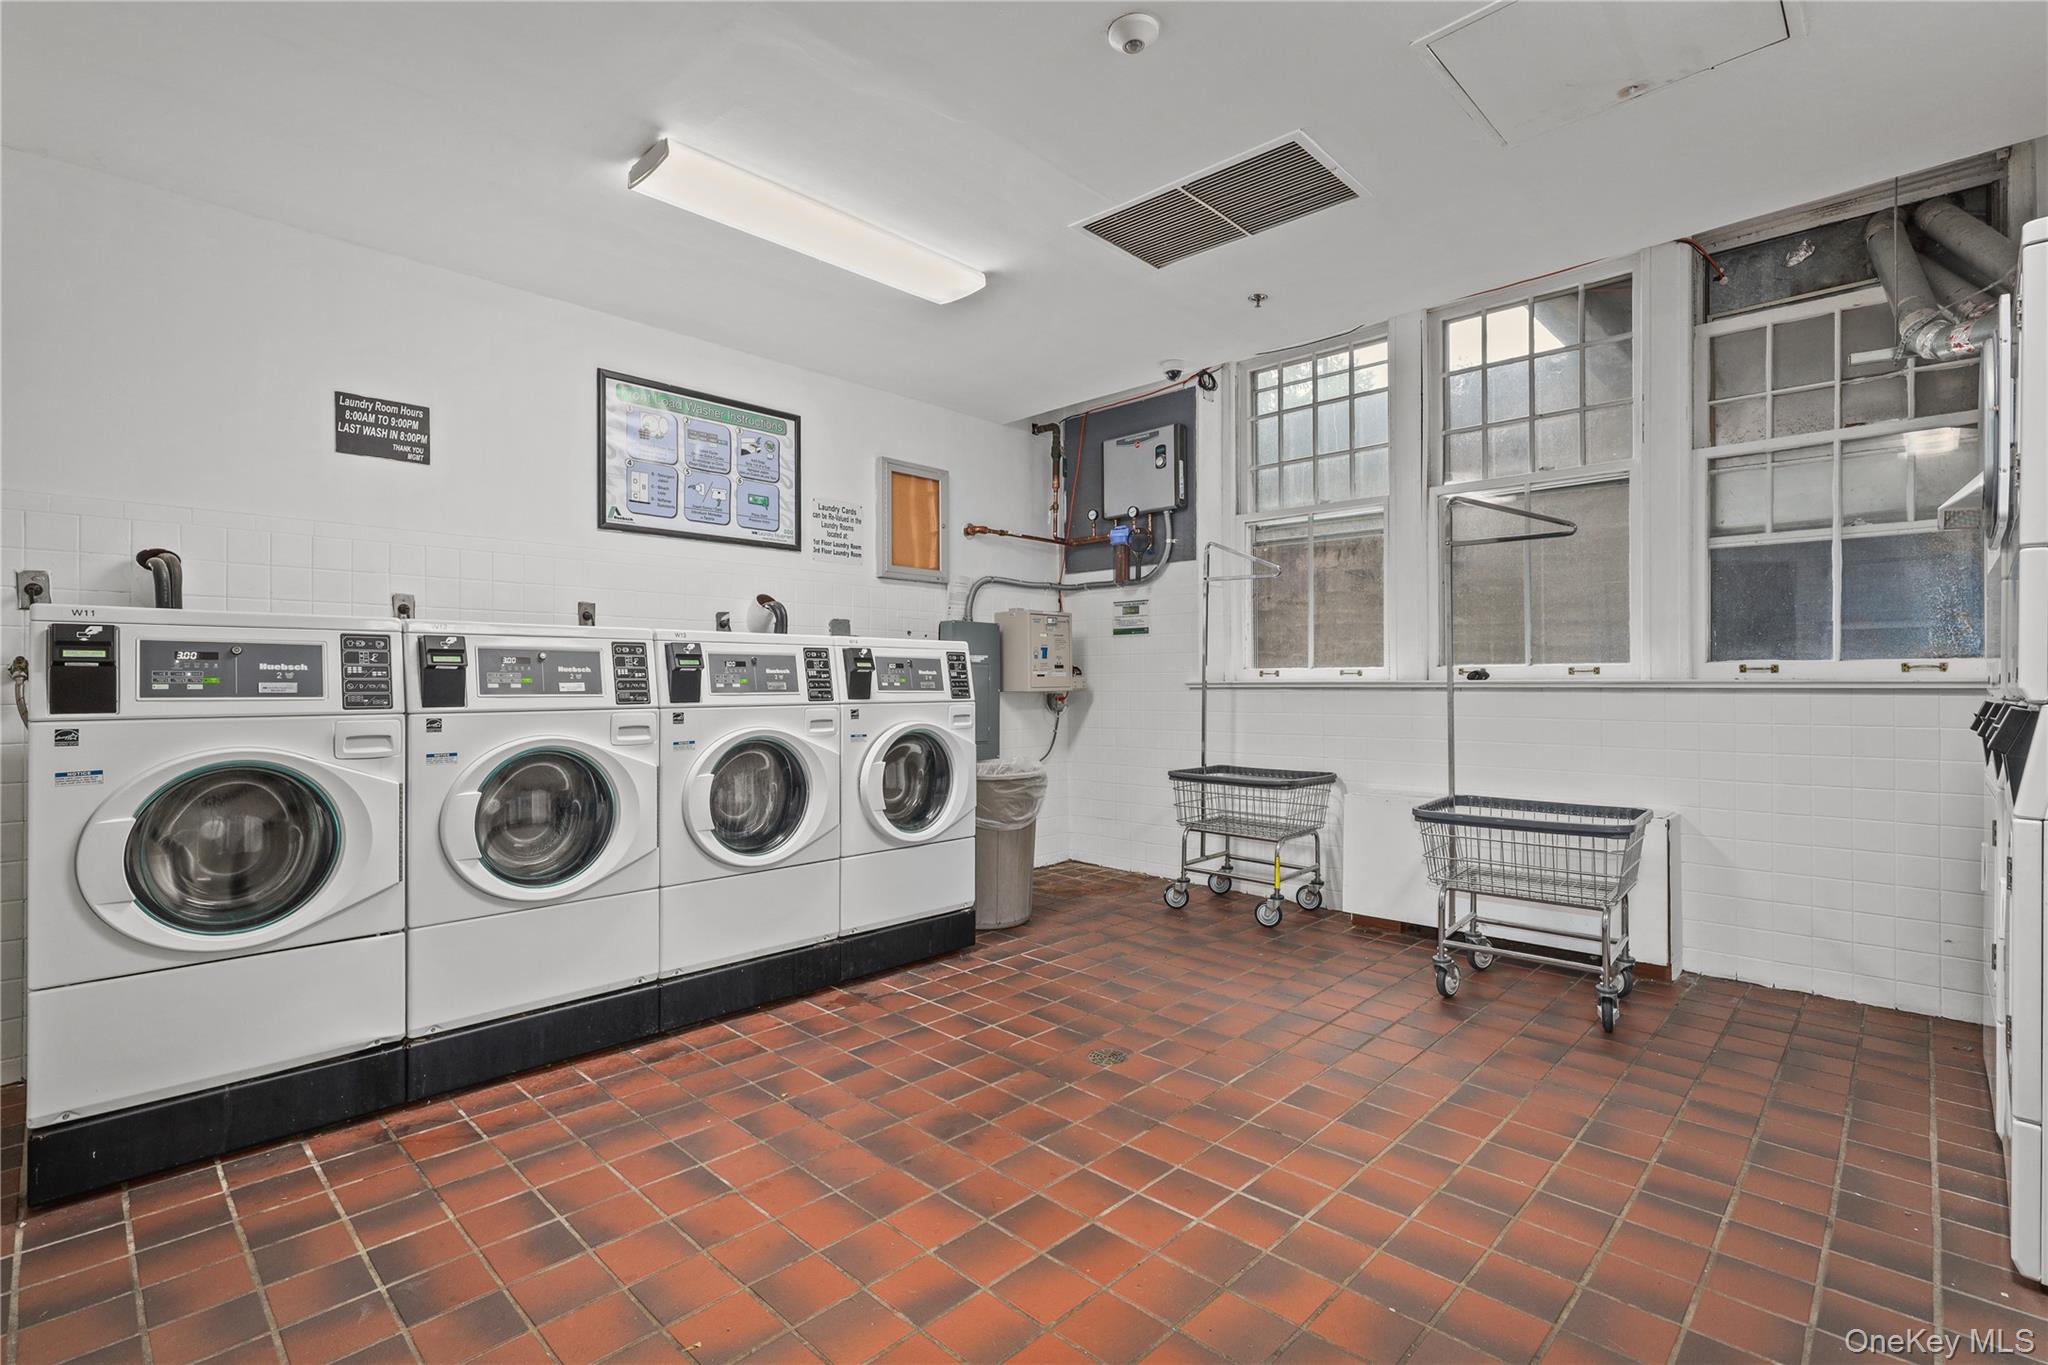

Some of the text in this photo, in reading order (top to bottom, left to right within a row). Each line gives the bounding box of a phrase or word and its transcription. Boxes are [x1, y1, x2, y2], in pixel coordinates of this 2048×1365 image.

[339, 395, 424, 418] Laundry Room Hours
[655, 391, 683, 409] Load
[686, 399, 724, 418] Washer
[726, 411, 784, 432] Instructions
[345, 410, 419, 430] 8:00AM TO 9:00PM
[337, 421, 428, 444] LAST WASH IN 8:00PM
[392, 444, 424, 454] THANK YOU
[407, 453, 424, 461] MGMT
[818, 503, 857, 515] Laundry Cards
[821, 521, 854, 532] Laundry Rooms
[826, 530, 842, 539] located
[833, 541, 849, 550] Laundry
[833, 549, 849, 558] Laundry
[71, 609, 96, 617] W11
[258, 662, 308, 672] Huebsch
